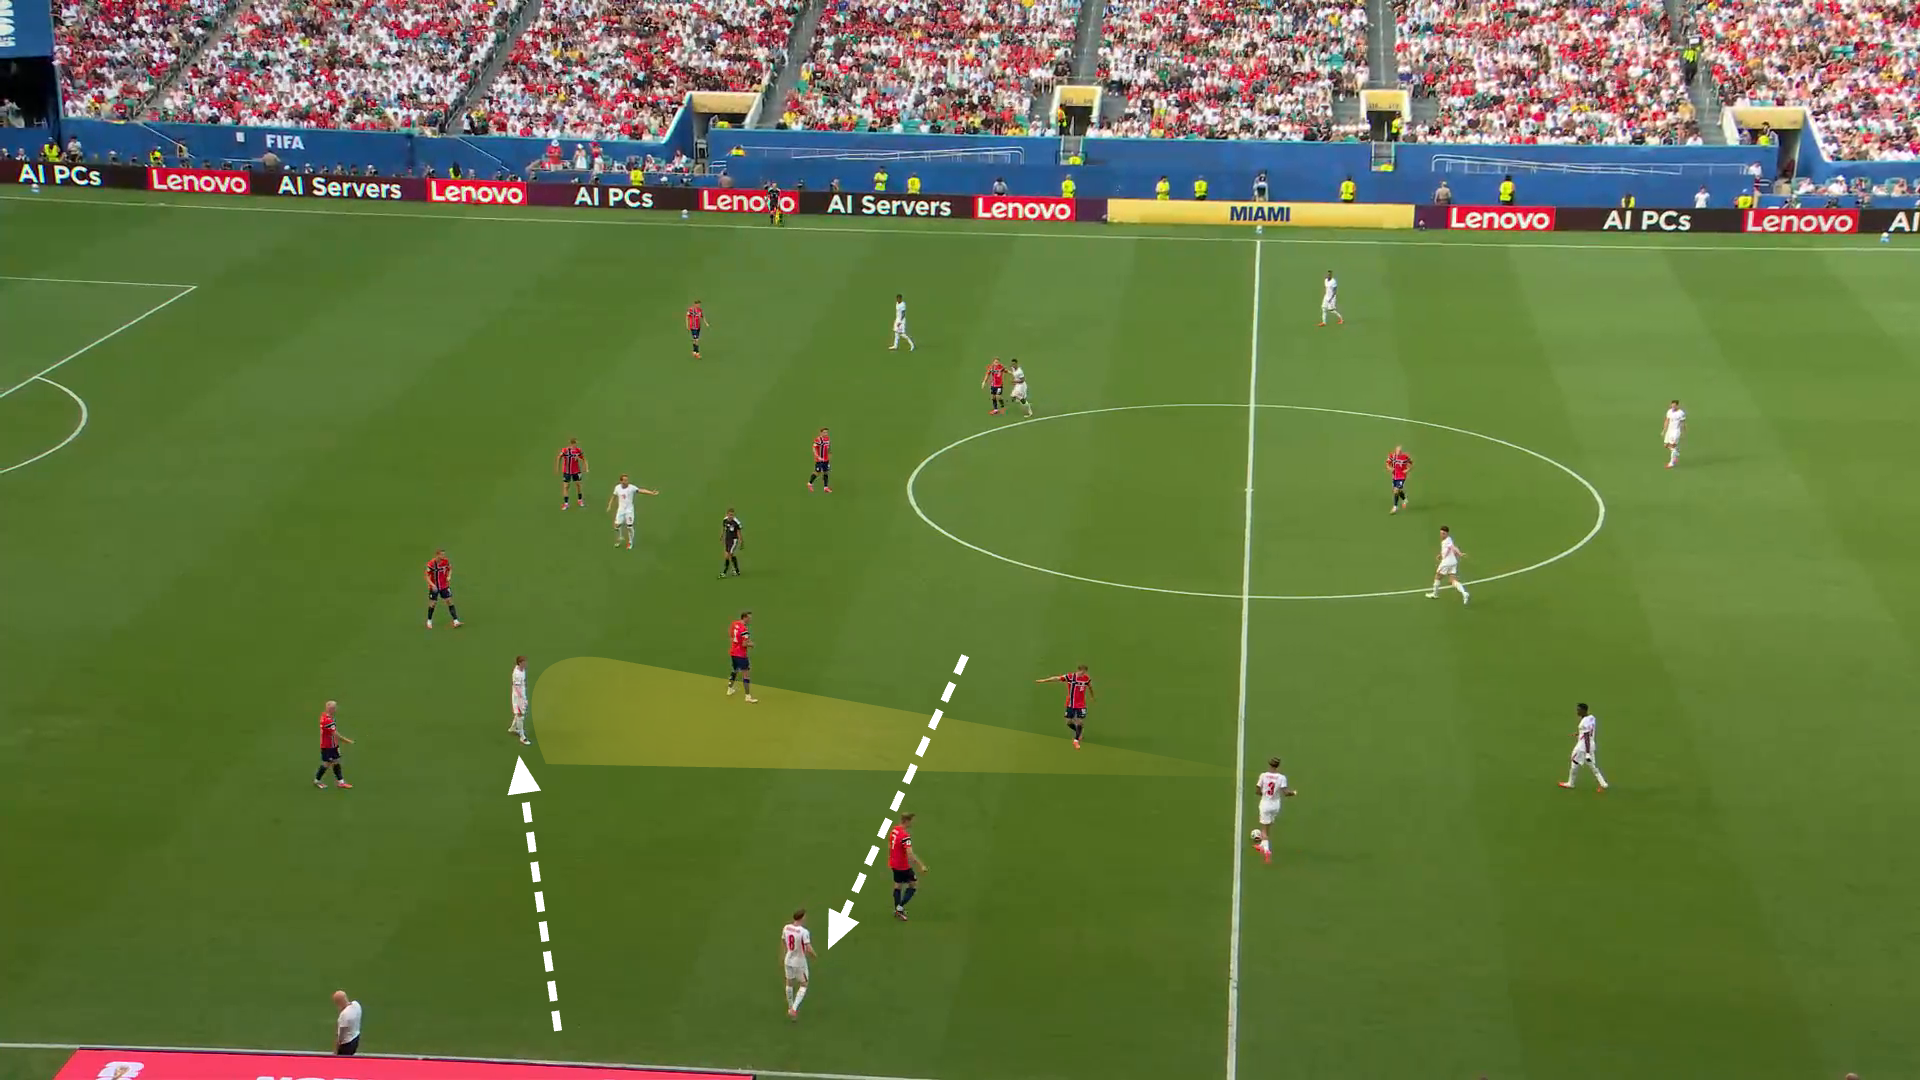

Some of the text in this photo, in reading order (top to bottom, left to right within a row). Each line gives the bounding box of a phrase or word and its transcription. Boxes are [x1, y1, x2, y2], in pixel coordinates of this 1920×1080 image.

[266, 134, 305, 150] FIFA
[19, 163, 101, 186] AI PCs
[152, 169, 247, 193] Lenovo
[278, 176, 402, 199] AI Servers
[431, 180, 523, 204] Lenovo
[574, 186, 654, 208] AI PCs
[703, 190, 795, 213] Lenoo
[827, 194, 952, 216] AI Servers
[977, 198, 1071, 219] Lenovo
[1229, 206, 1291, 222] MIAMI
[1451, 207, 1550, 229] Lenovo
[1603, 210, 1692, 231] AI PCs
[1746, 211, 1853, 233] Lenovo
[1888, 212, 1920, 232] AI
[1267, 781, 1275, 796] 3
[788, 934, 795, 951] 8
